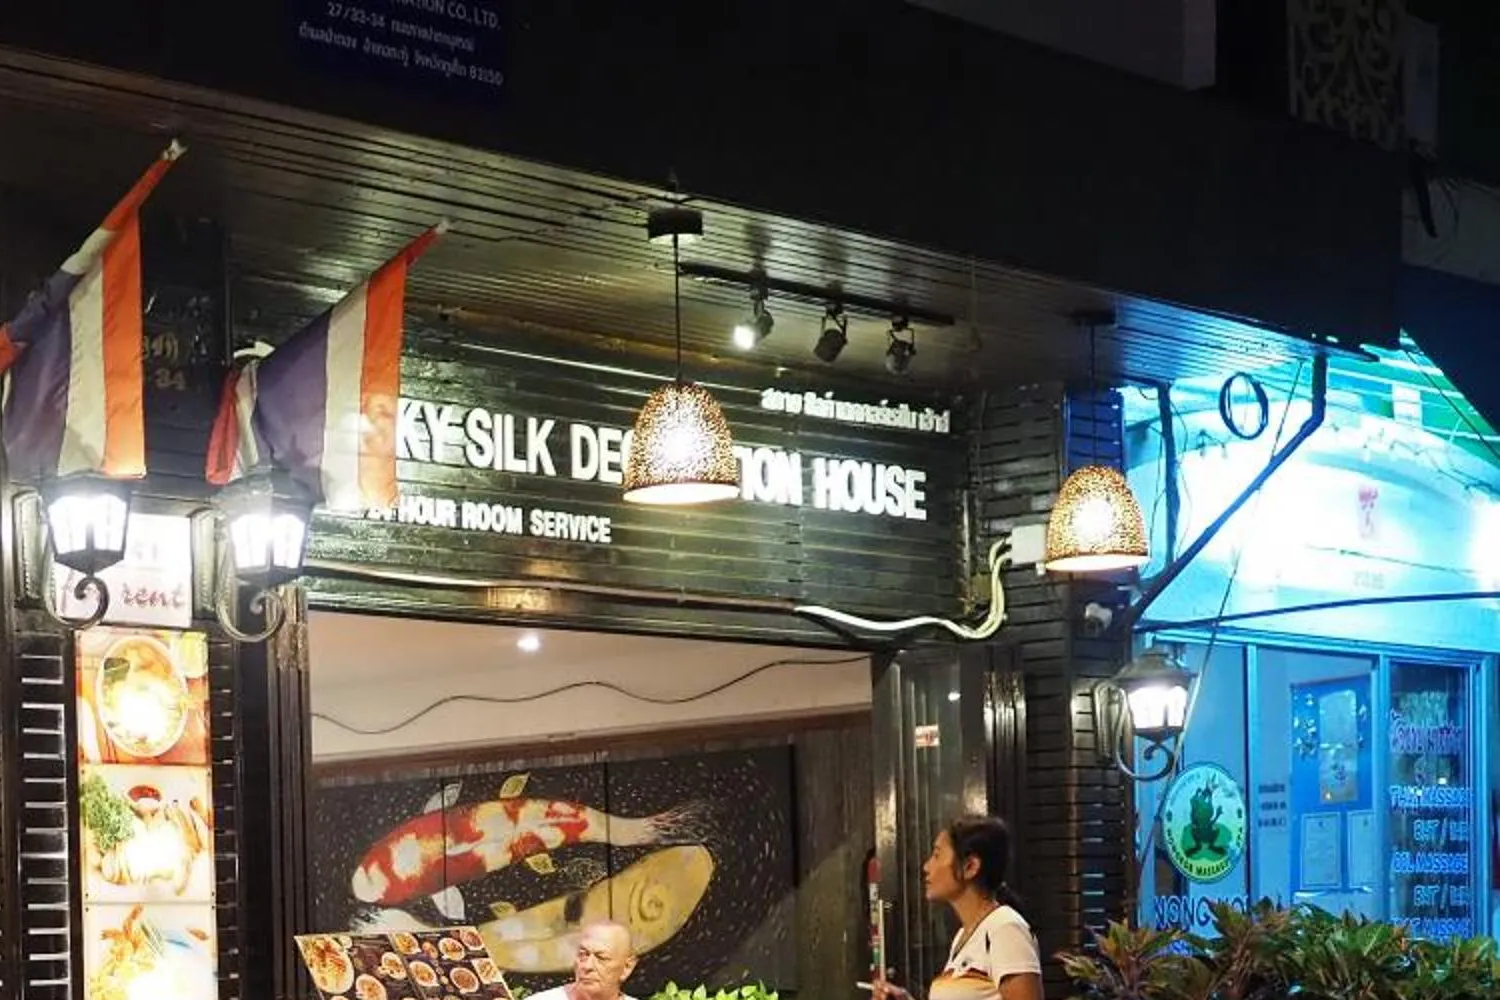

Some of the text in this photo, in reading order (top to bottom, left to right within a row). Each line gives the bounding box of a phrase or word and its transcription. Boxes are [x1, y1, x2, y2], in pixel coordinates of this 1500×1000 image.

[464, 403, 557, 478] SILK
[813, 457, 927, 521] HOUSE
[398, 494, 457, 528] HOUR
[461, 500, 522, 535] ROOM
[529, 508, 612, 544] SERVICE
